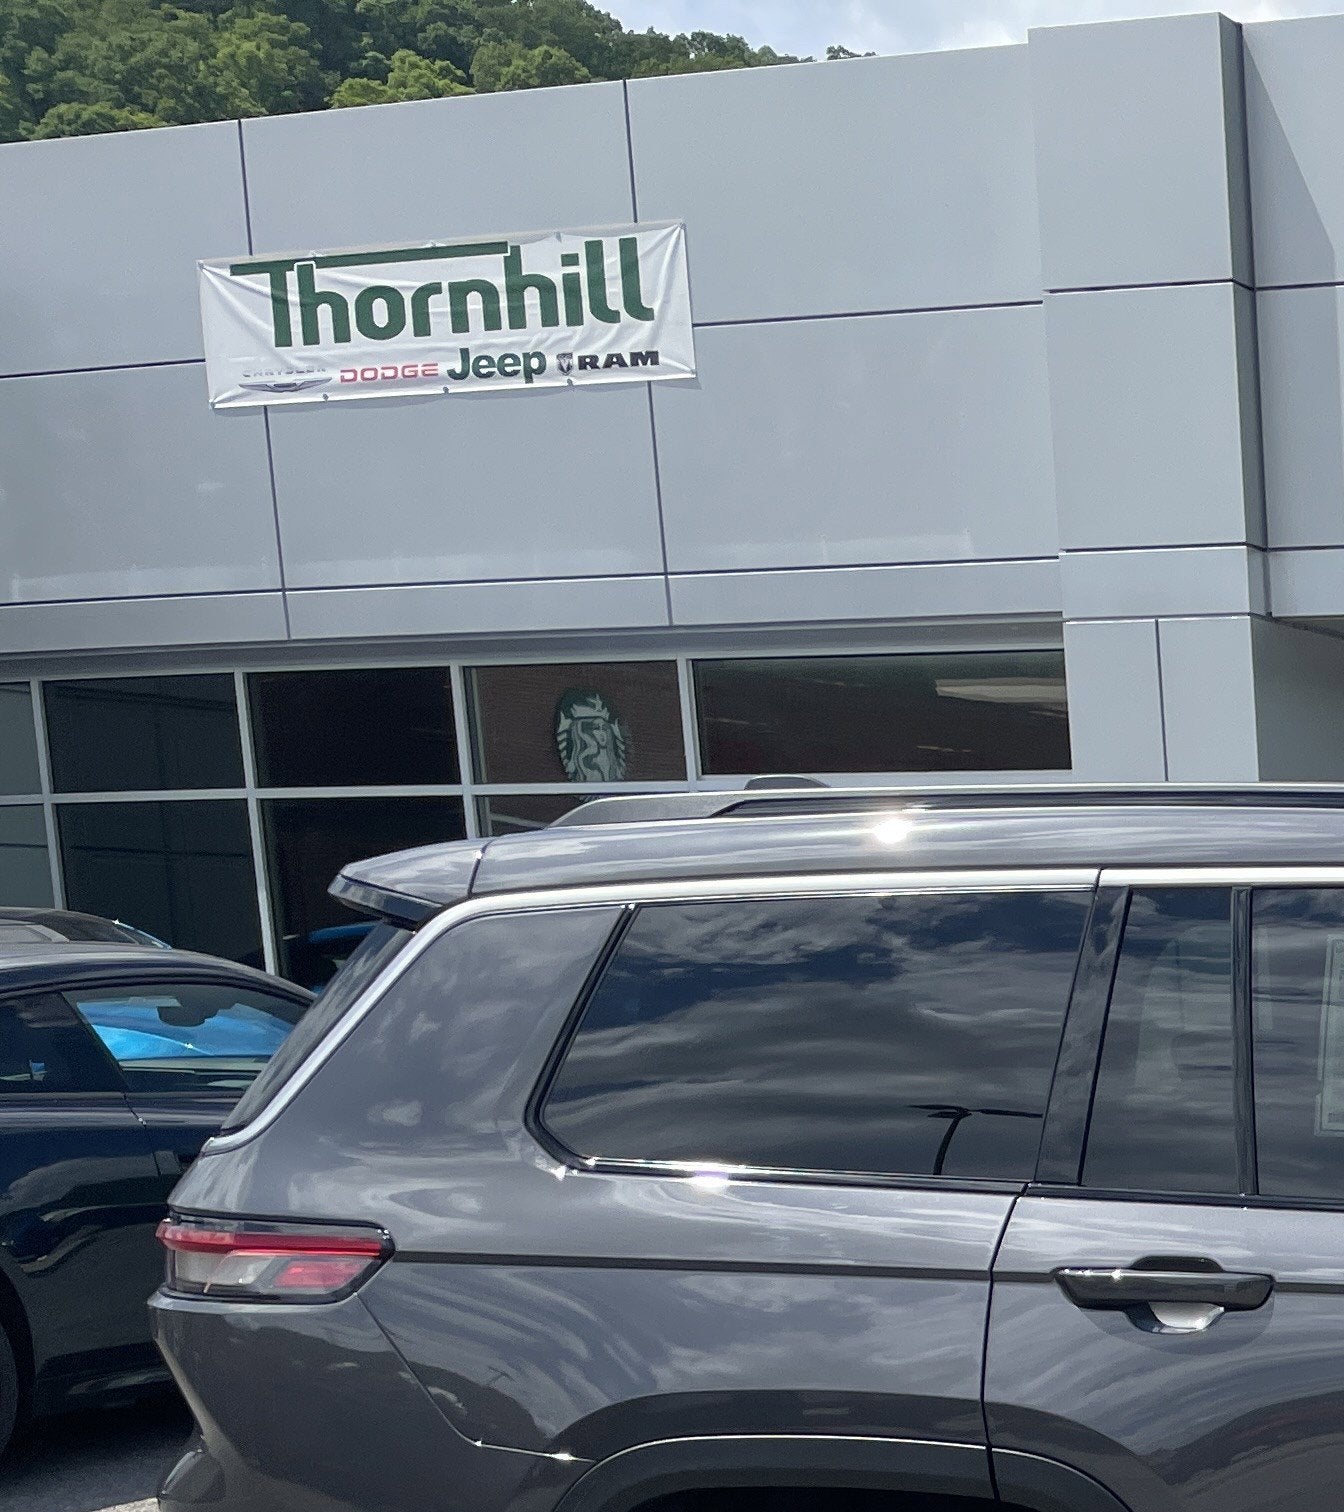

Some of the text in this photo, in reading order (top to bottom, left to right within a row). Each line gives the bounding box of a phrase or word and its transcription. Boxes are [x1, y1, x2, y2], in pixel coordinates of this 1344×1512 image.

[229, 236, 655, 348] Thornhill
[339, 362, 439, 384] DODGE
[446, 347, 547, 384] Jeep
[578, 350, 660, 371] RAM
